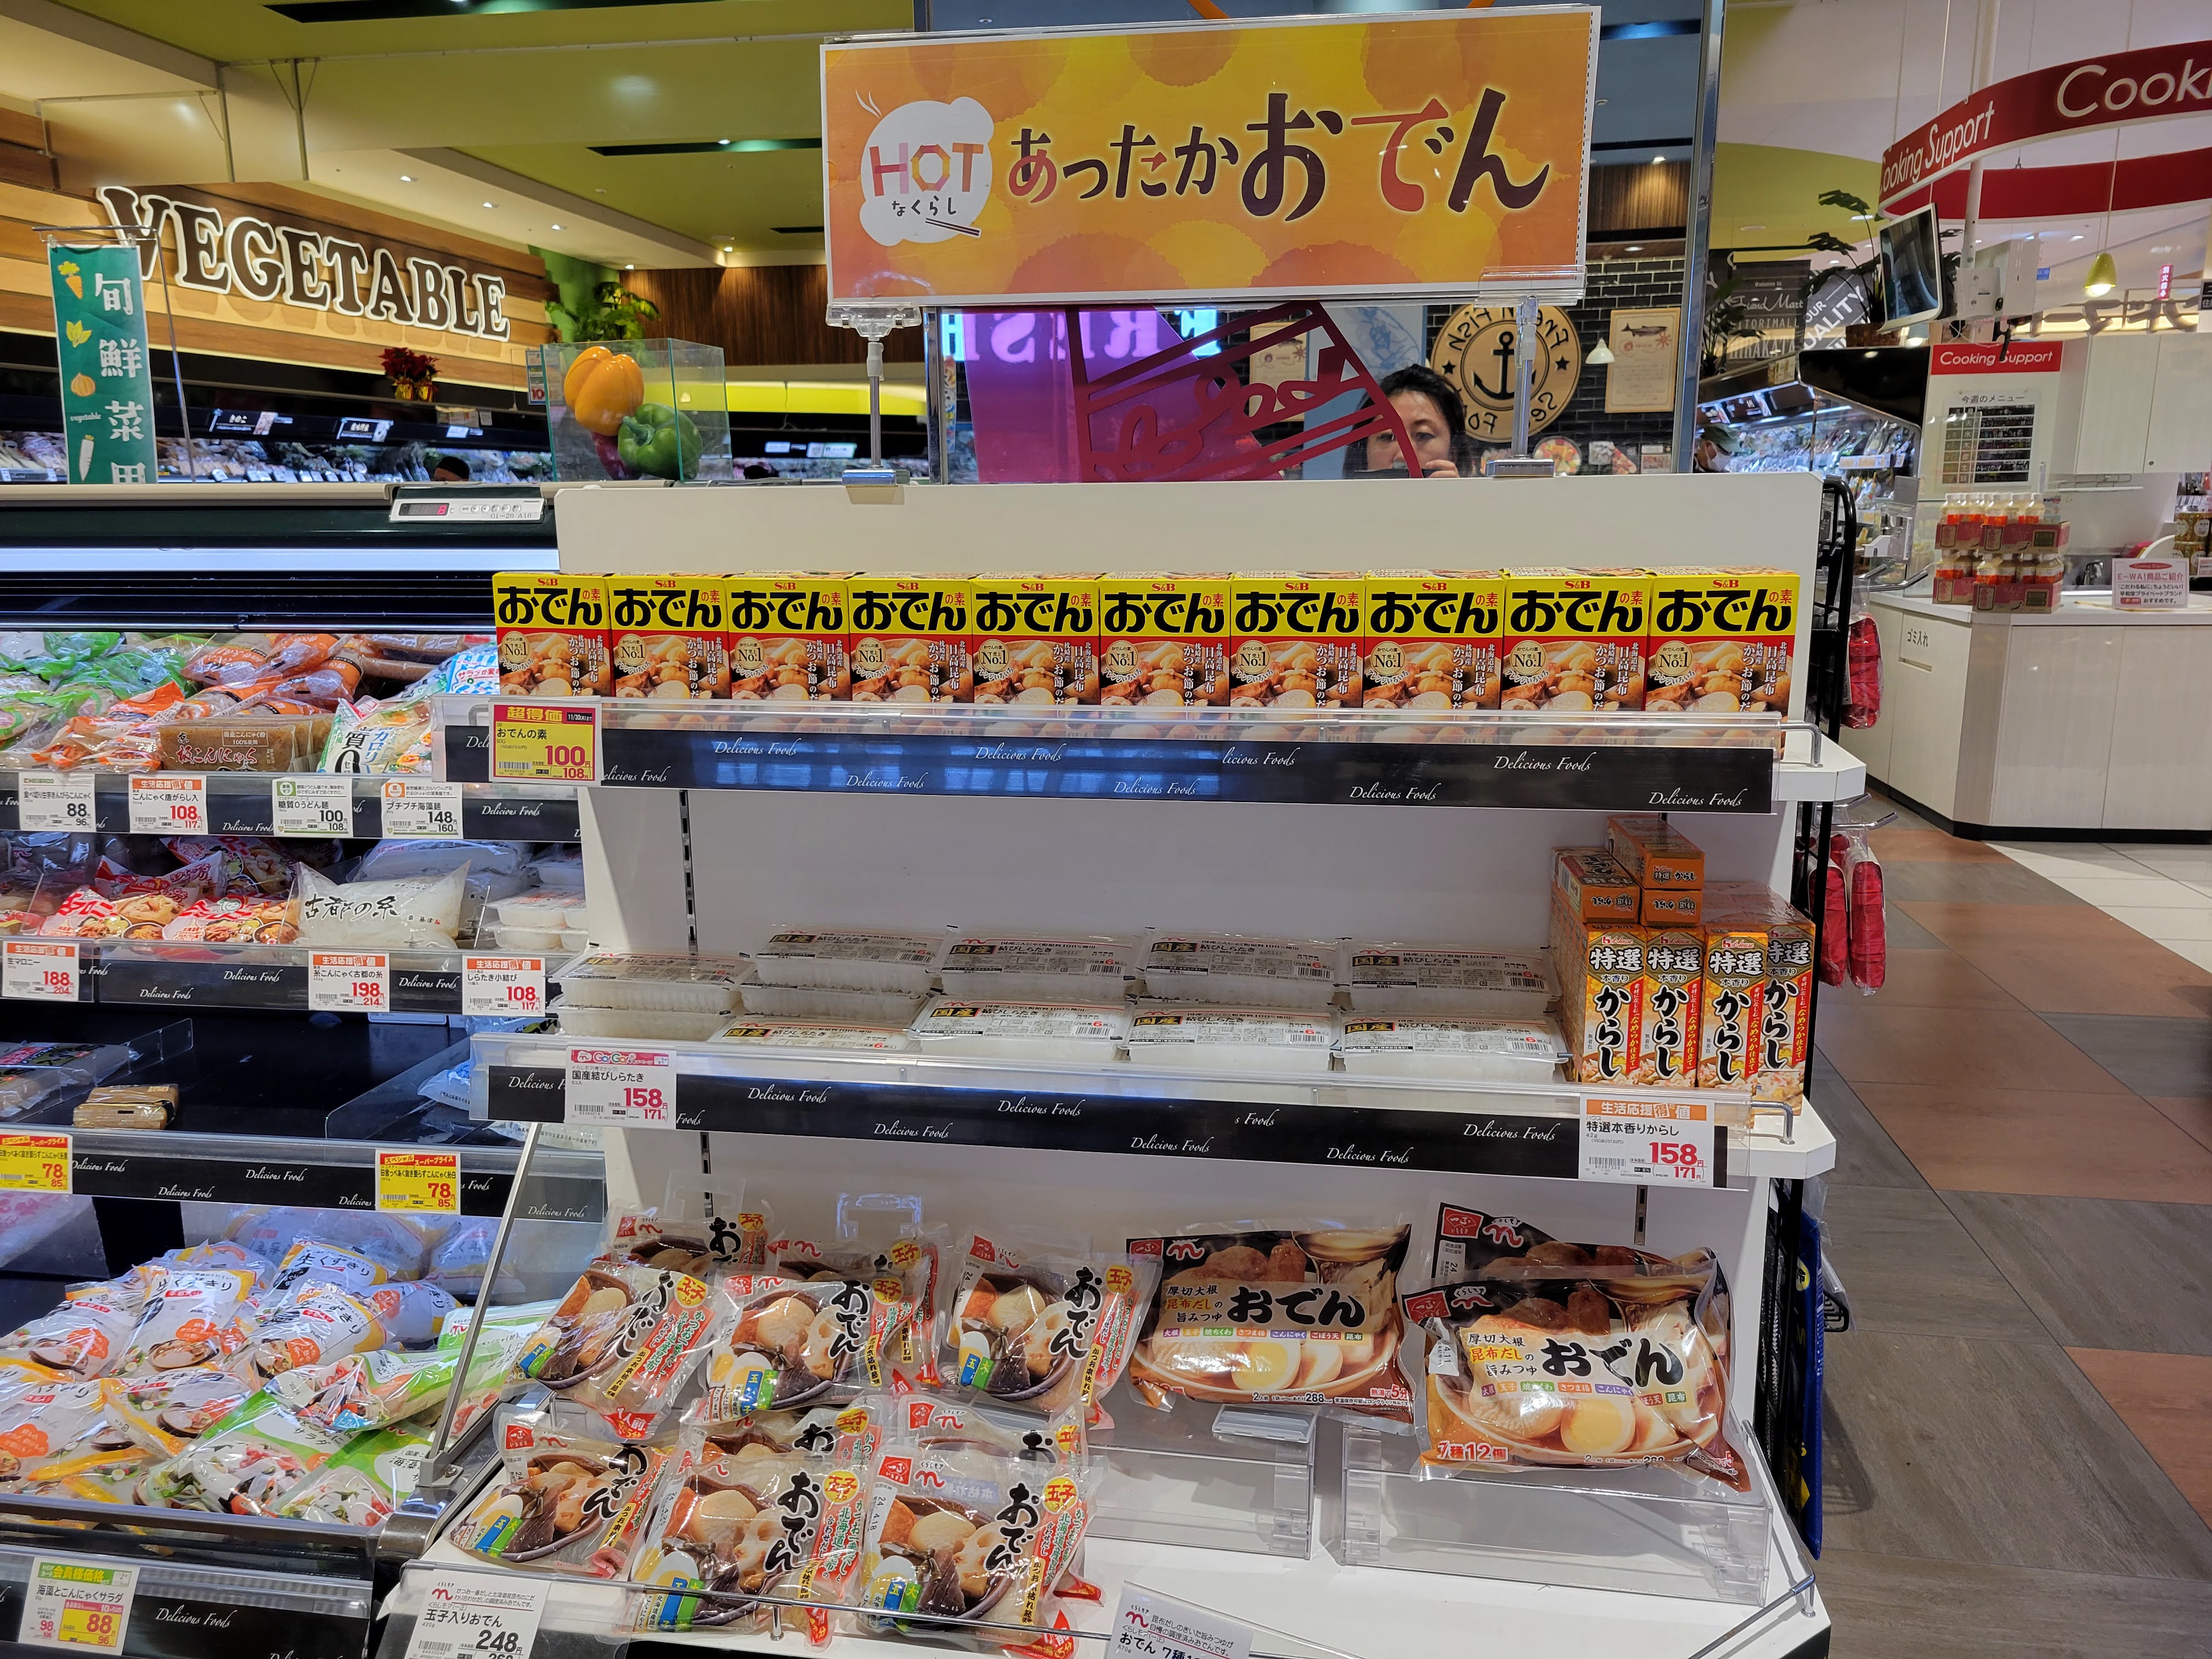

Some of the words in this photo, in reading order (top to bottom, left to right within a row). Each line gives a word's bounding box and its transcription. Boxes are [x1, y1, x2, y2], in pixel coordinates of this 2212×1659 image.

[1925, 100, 1995, 168] Support
[869, 143, 984, 196] HOT
[891, 195, 957, 217] なくらし
[97, 185, 510, 342] VEGETABLE
[1734, 318, 1799, 329] ITORIMALL
[1803, 285, 1865, 349] UALITY
[1940, 352, 1996, 366] Cooking
[1962, 395, 2025, 404] 今週のメニュー
[70, 412, 102, 422] vegetable
[655, 580, 676, 588] S&B
[1152, 583, 1175, 591] S&B
[1422, 583, 1447, 591] S&B
[1713, 579, 1739, 588] S&B
[498, 586, 603, 626] おでん
[614, 589, 722, 628] おでん
[731, 591, 843, 630] おでん
[853, 591, 966, 631] おでん
[976, 592, 1093, 633] おでん
[1104, 592, 1224, 633] おでん
[1235, 591, 1359, 633] おでん
[1370, 591, 1498, 634] おでん
[1510, 590, 1643, 633] おでん
[1656, 589, 1791, 632] おでん
[1907, 630, 1928, 648] ゴミ入れ
[588, 639, 599, 684] 日高昆布
[1756, 642, 1764, 665] 枕崎産
[1778, 642, 1787, 672] 北海道産
[853, 663, 890, 679] アレンジいろいろ
[949, 644, 960, 690] 日高昆布
[1232, 669, 1273, 683] アレンジいろいろ
[1764, 646, 1778, 696] 日高昆布
[1650, 670, 1695, 685] アレンジいろいろ
[507, 707, 563, 723] 超得価
[497, 728, 548, 740] おでんの素
[177, 745, 258, 764] 板こんにゃく
[715, 738, 763, 755] Delicious
[768, 738, 800, 755] Foods
[975, 742, 1026, 760] Delicious
[1031, 743, 1066, 761] Foods
[1263, 748, 1300, 766] Foods
[1494, 751, 1551, 770] Delicious
[1557, 752, 1596, 771] Foods
[133, 793, 198, 802] こんにゃく唐がらし入
[278, 800, 329, 809] 糖質0うどん麺
[386, 802, 441, 810] プチプチ海藻麺
[1649, 787, 1703, 805] Delicious
[1709, 788, 1748, 806] Foods
[482, 805, 517, 816] Delicious
[520, 806, 540, 816] Foods
[223, 820, 253, 832] Delicious
[306, 894, 399, 921] 古都の糸
[952, 945, 994, 954] 国産
[1647, 947, 1701, 971] 特選
[1353, 956, 1398, 966] 国産
[1403, 956, 1460, 964] 結びしらたき
[1590, 947, 1644, 972] 特選
[1709, 951, 1764, 974] 特選
[224, 968, 257, 981] Delicious
[261, 969, 283, 983] Foods
[313, 969, 382, 979] 糸こんにゃく古都の糸
[399, 976, 433, 988] Delicious
[436, 977, 460, 989] Foods
[468, 974, 517, 982] しらたき小結び
[1601, 974, 1629, 983] 本香り
[1720, 977, 1749, 987] 本香り
[934, 1008, 977, 1017] 国産
[1594, 986, 1630, 1080] からし
[1653, 986, 1688, 1080] からし
[1763, 978, 1798, 1070] からし
[1713, 989, 1750, 1084] からし
[572, 1070, 644, 1082] 国産結びしらたき
[998, 1097, 1047, 1114] Delicious
[1052, 1099, 1086, 1116] Foods
[1464, 1120, 1518, 1139] Delicious
[1523, 1123, 1560, 1141] Foods
[1586, 1121, 1679, 1136] 特選本香りからし
[386, 1155, 413, 1164] スペシャル
[415, 1156, 454, 1166] スーパープライス
[1108, 1268, 1132, 1286] 玉子
[874, 1280, 902, 1296] 玉子
[1167, 1285, 1218, 1296] 厚切大根
[1049, 1266, 1103, 1359] おでん
[1166, 1299, 1223, 1311] 昆布だしの
[1227, 1286, 1365, 1327] おでん
[829, 1280, 871, 1358] おでん
[1176, 1312, 1222, 1323] 旨みつゆ
[1164, 1329, 1180, 1338] 大根
[1183, 1328, 1200, 1337] 玉子
[1204, 1328, 1233, 1336] 焼ちくわ
[1238, 1328, 1266, 1338] さつま揚
[1272, 1330, 1307, 1339] こんにゃく
[1311, 1331, 1341, 1340] ごぼう天
[1346, 1333, 1362, 1341] 昆布
[1468, 1333, 1525, 1347] 厚切大根
[1471, 1347, 1534, 1361] 昆布だしの
[1541, 1338, 1683, 1386] おでん
[1486, 1363, 1538, 1376] 旨みつゆ
[1558, 1383, 1590, 1392] さつま揚
[1595, 1384, 1634, 1396] こんにゃく
[1667, 1392, 1685, 1403] 昆布
[1437, 1441, 1509, 1462] 7種12個
[825, 1474, 857, 1494] 玉子
[1046, 1480, 1077, 1503] 玉子
[36, 1584, 124, 1603] 海藻とこんにゃくサラダ
[424, 1609, 503, 1628] 玉子入りおでん
[1150, 1623, 1229, 1657] 自慢の調理済みおでんです。
[1152, 1615, 1234, 1649] 昆布だしのきいた旨みつゆが
